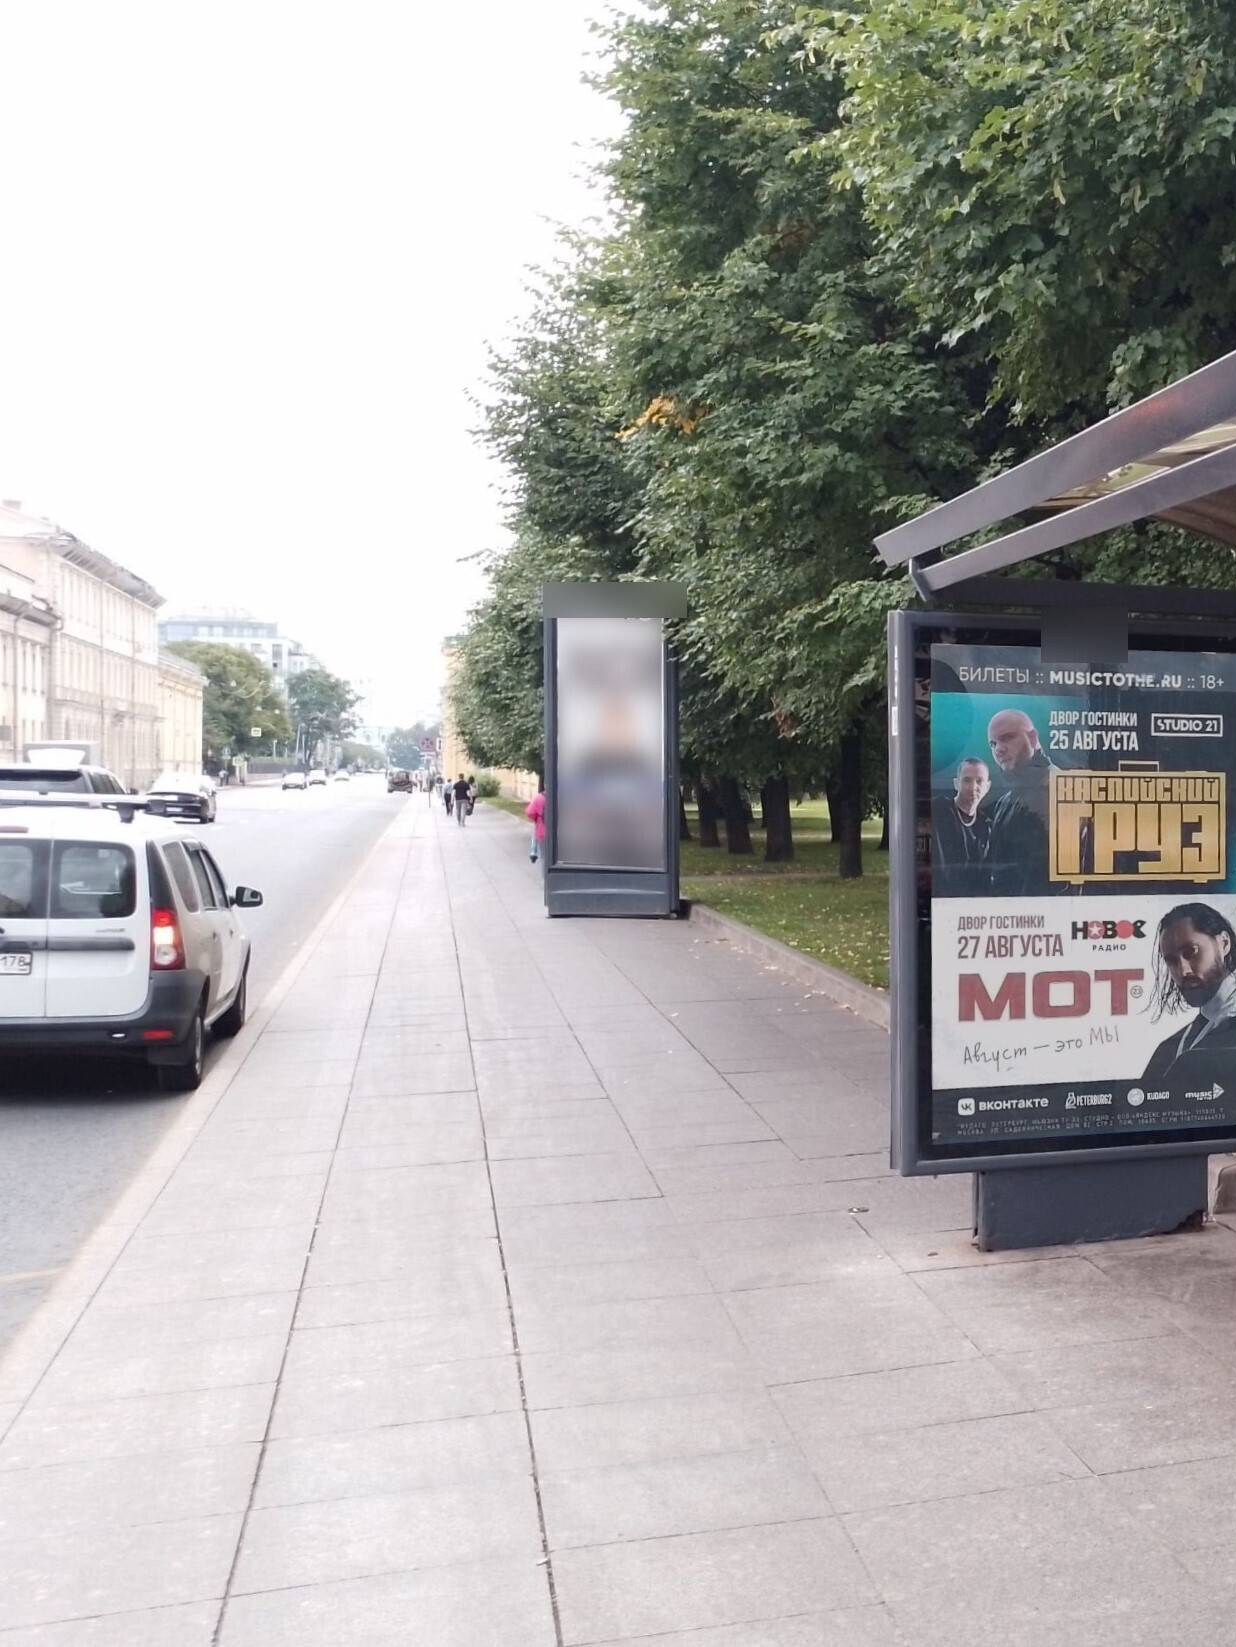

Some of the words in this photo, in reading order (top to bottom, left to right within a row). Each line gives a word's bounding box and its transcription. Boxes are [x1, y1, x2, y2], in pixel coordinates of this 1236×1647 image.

[959, 666, 1029, 683] БИЛЕТЫ
[1049, 671, 1182, 688] MUSICTOTHE.RU
[1200, 675, 1224, 689] 18+
[1049, 710, 1079, 726] ДВОР
[1081, 711, 1138, 727] ГОСТИНКИ
[1157, 719, 1202, 731] STUDIO
[1205, 720, 1218, 731] 21
[1049, 730, 1069, 749] 25
[1072, 731, 1139, 751] АВГУСТА
[1057, 777, 1219, 802] КАСПИЙСКИЙ
[1057, 803, 1219, 873] ГРУЗ
[957, 917, 987, 931] ДВОР
[989, 915, 1045, 930] ГОСТИНКИ
[958, 936, 980, 959] 27
[984, 934, 1064, 958] АВГУСТА
[958, 969, 1144, 1022] МОТ
[963, 1042, 1027, 1072] Август
[1054, 1038, 1083, 1053] это
[1089, 1025, 1119, 1046] МЫ
